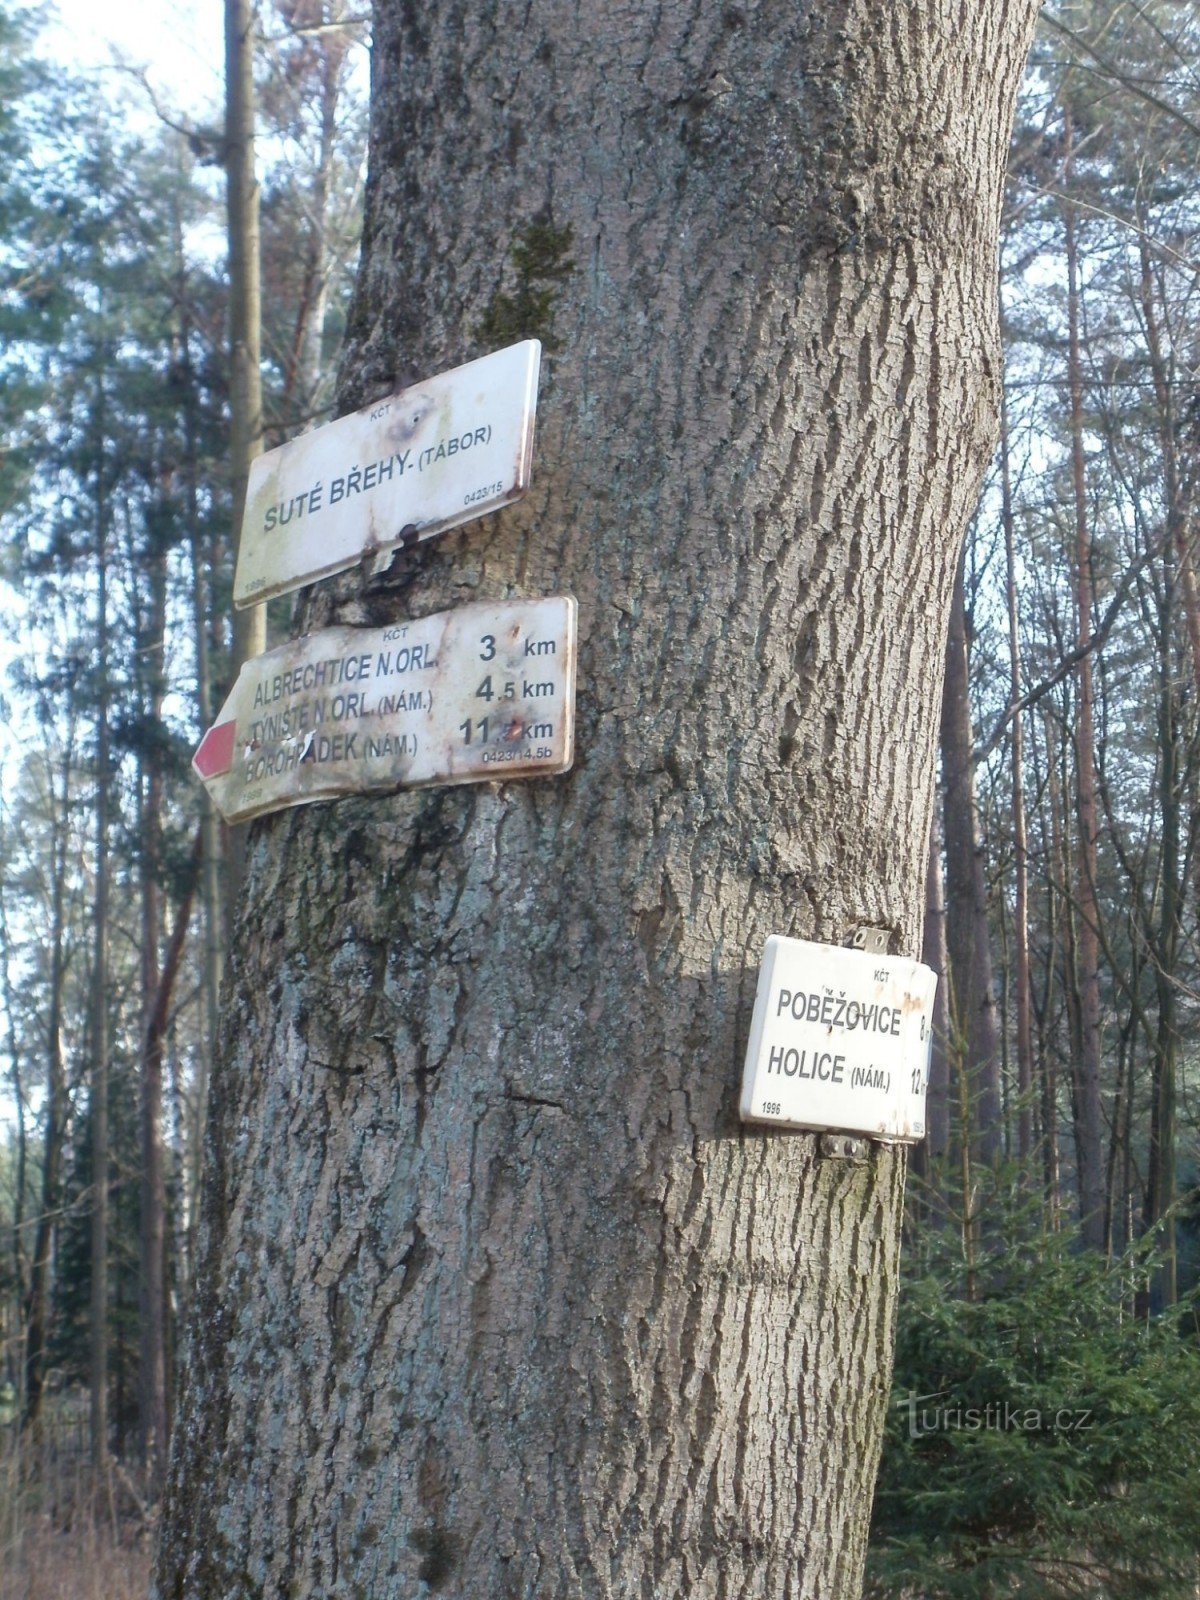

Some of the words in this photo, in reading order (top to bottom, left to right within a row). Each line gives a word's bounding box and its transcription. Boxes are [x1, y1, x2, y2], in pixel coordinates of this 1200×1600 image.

[263, 481, 323, 533] SUTÉ
[418, 424, 492, 472] (TÁBOR)
[463, 480, 503, 506] 0423/15
[382, 626, 409, 642] KČT
[253, 655, 371, 711] ALBRECHTICE
[376, 644, 439, 681] N.ORL.
[479, 634, 497, 662] 3
[523, 637, 556, 657] km
[377, 689, 434, 716] (NÁM.)
[522, 680, 555, 699] km
[363, 733, 418, 762] (NÁM.)
[521, 720, 554, 739] km
[873, 968, 890, 983] KČT
[776, 987, 902, 1036] POBĚŽOVICE
[767, 1045, 846, 1084] HOLICE
[850, 1064, 891, 1094] (NÁM.)
[761, 1101, 782, 1116] 1996
